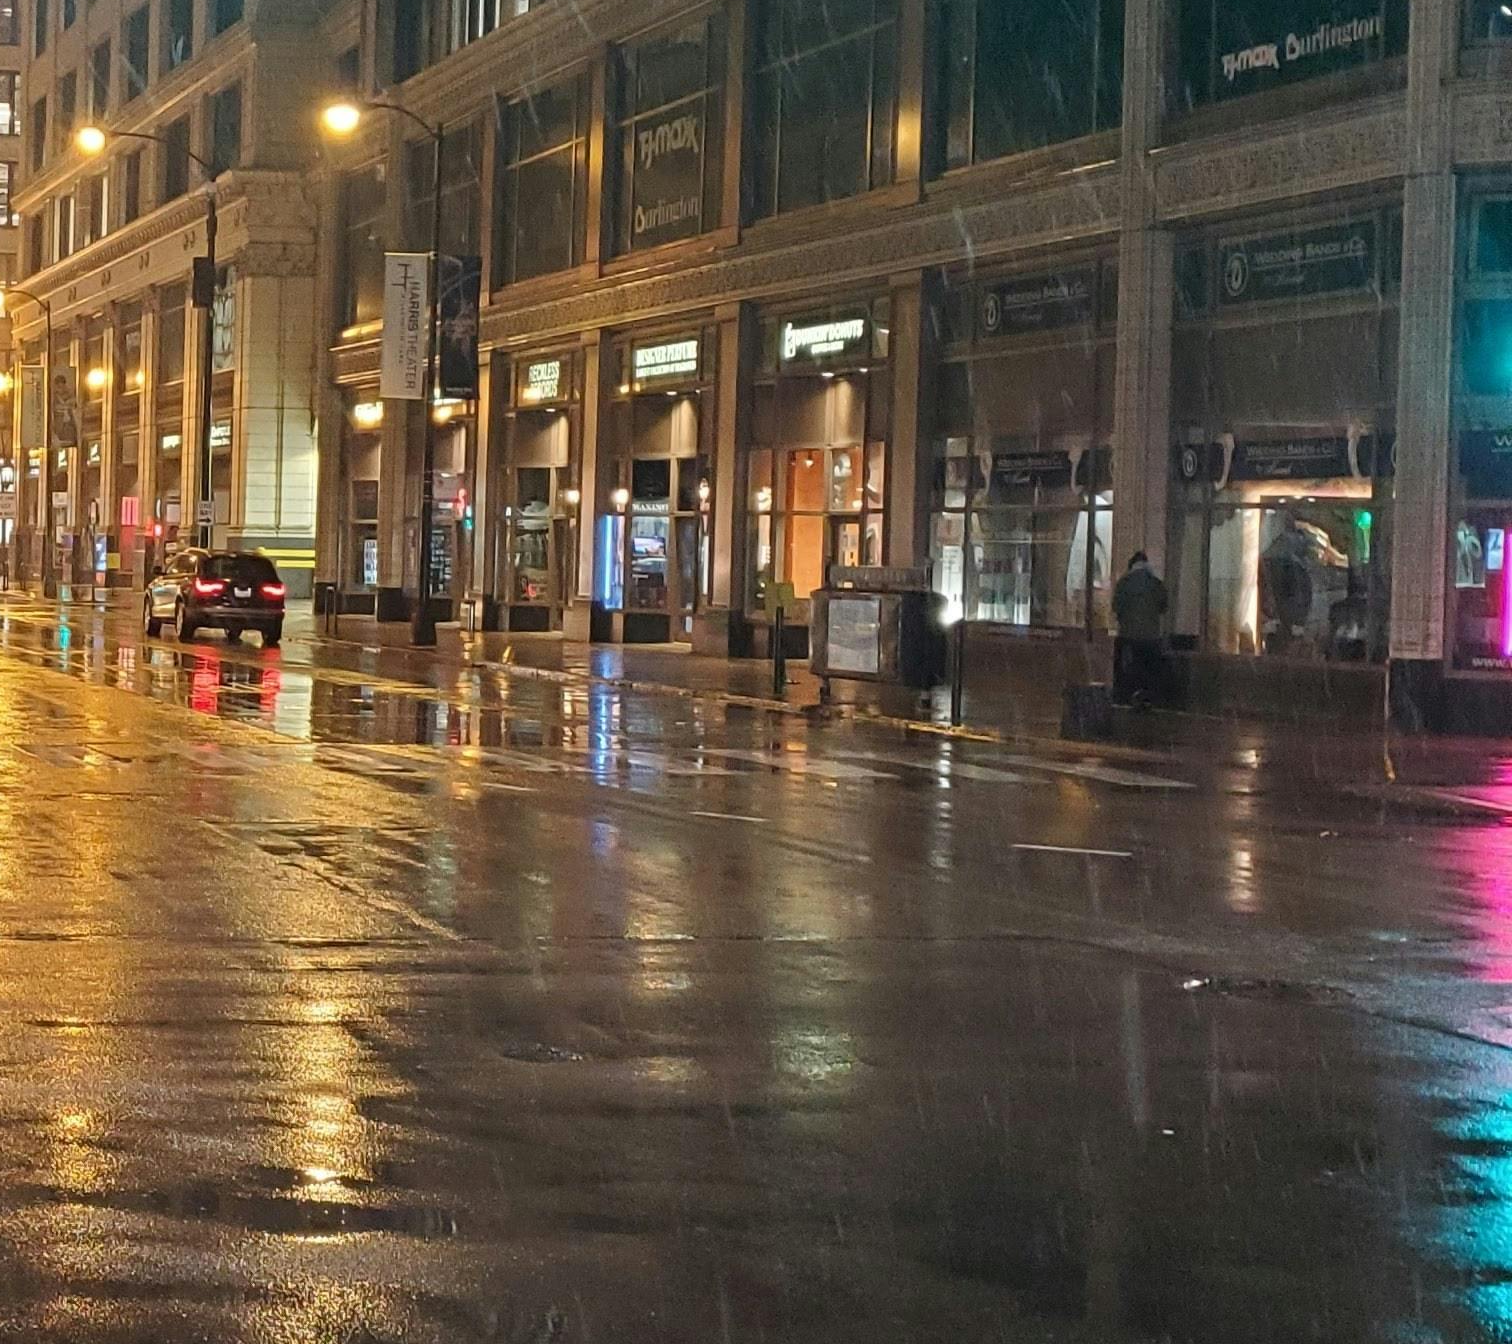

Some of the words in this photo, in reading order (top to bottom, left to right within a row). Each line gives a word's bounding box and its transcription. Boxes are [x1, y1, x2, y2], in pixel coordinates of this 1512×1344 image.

[1286, 15, 1382, 61] Burlington
[634, 196, 700, 233] Burlington
[407, 280, 421, 332] HARRIS
[405, 335, 419, 389] THEATER
[529, 361, 559, 382] RECKLESS
[529, 380, 558, 399] CORDS
